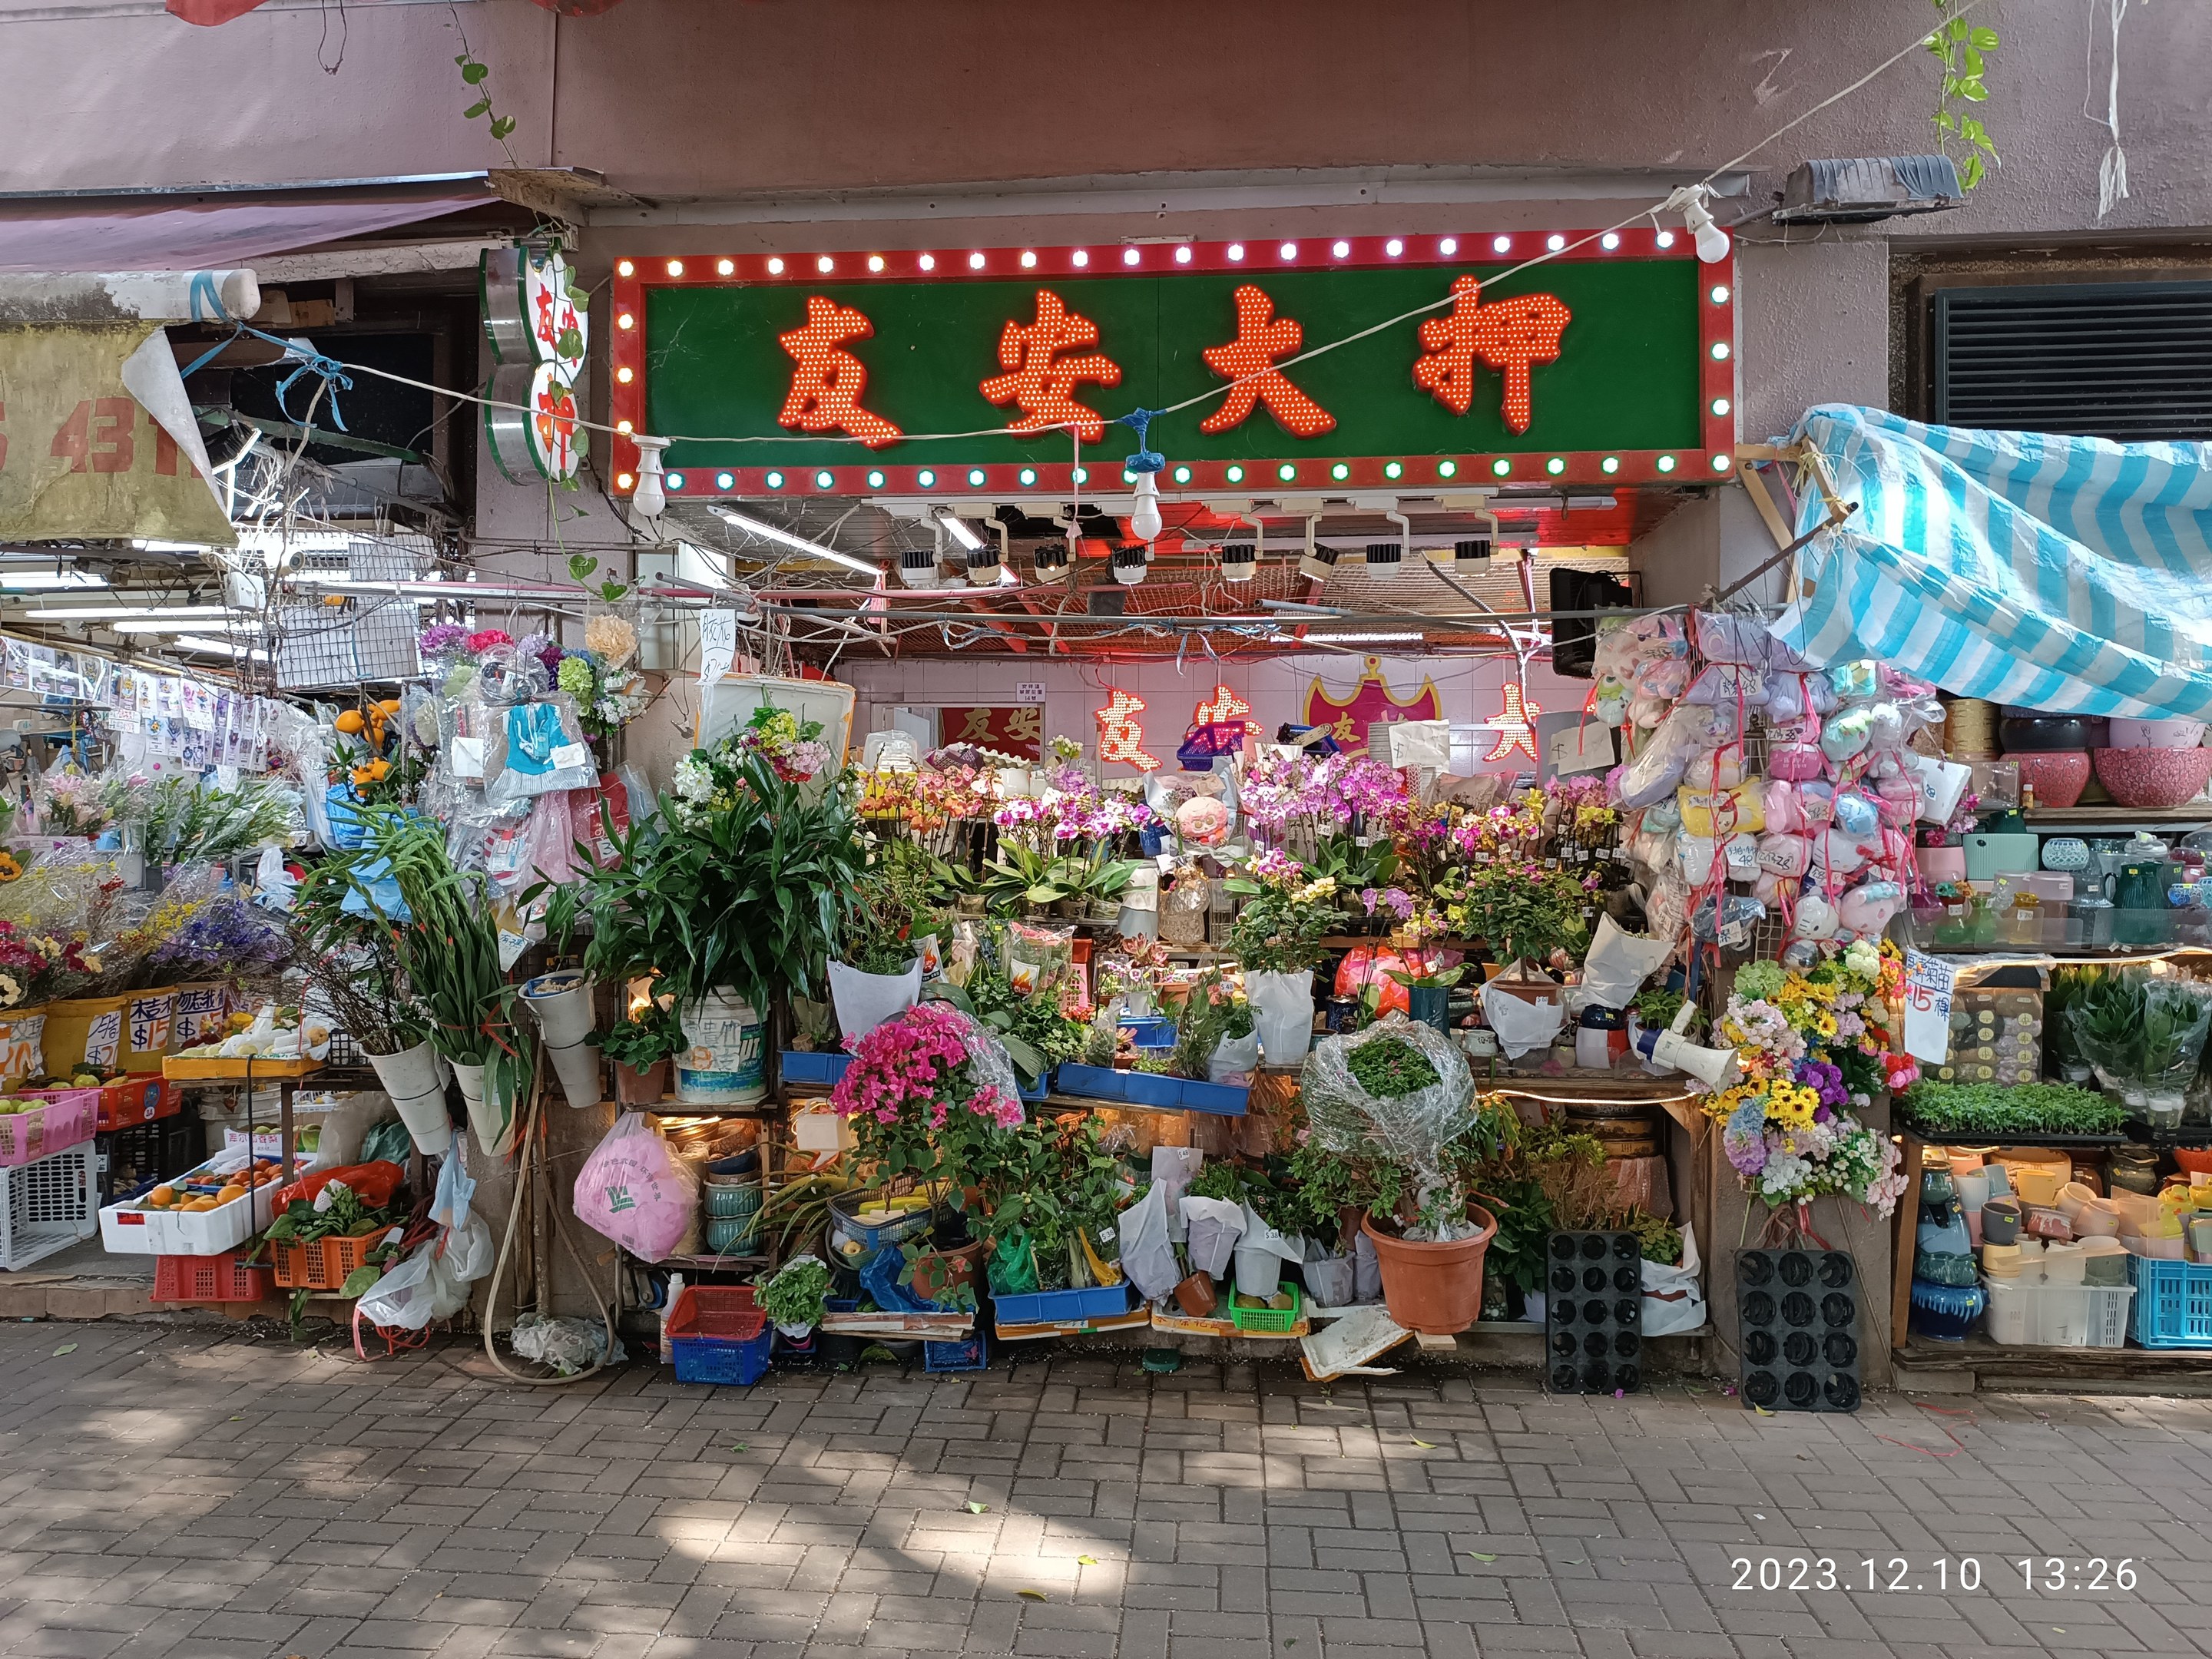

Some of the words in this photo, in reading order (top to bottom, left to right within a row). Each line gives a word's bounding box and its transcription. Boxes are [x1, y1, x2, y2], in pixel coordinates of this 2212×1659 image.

[777, 275, 1571, 449] 友安大押
[50, 397, 206, 479] 431
[603, 842, 614, 856] 3
[1738, 855, 1753, 866] 48
[1101, 1230, 1114, 1240] $38
